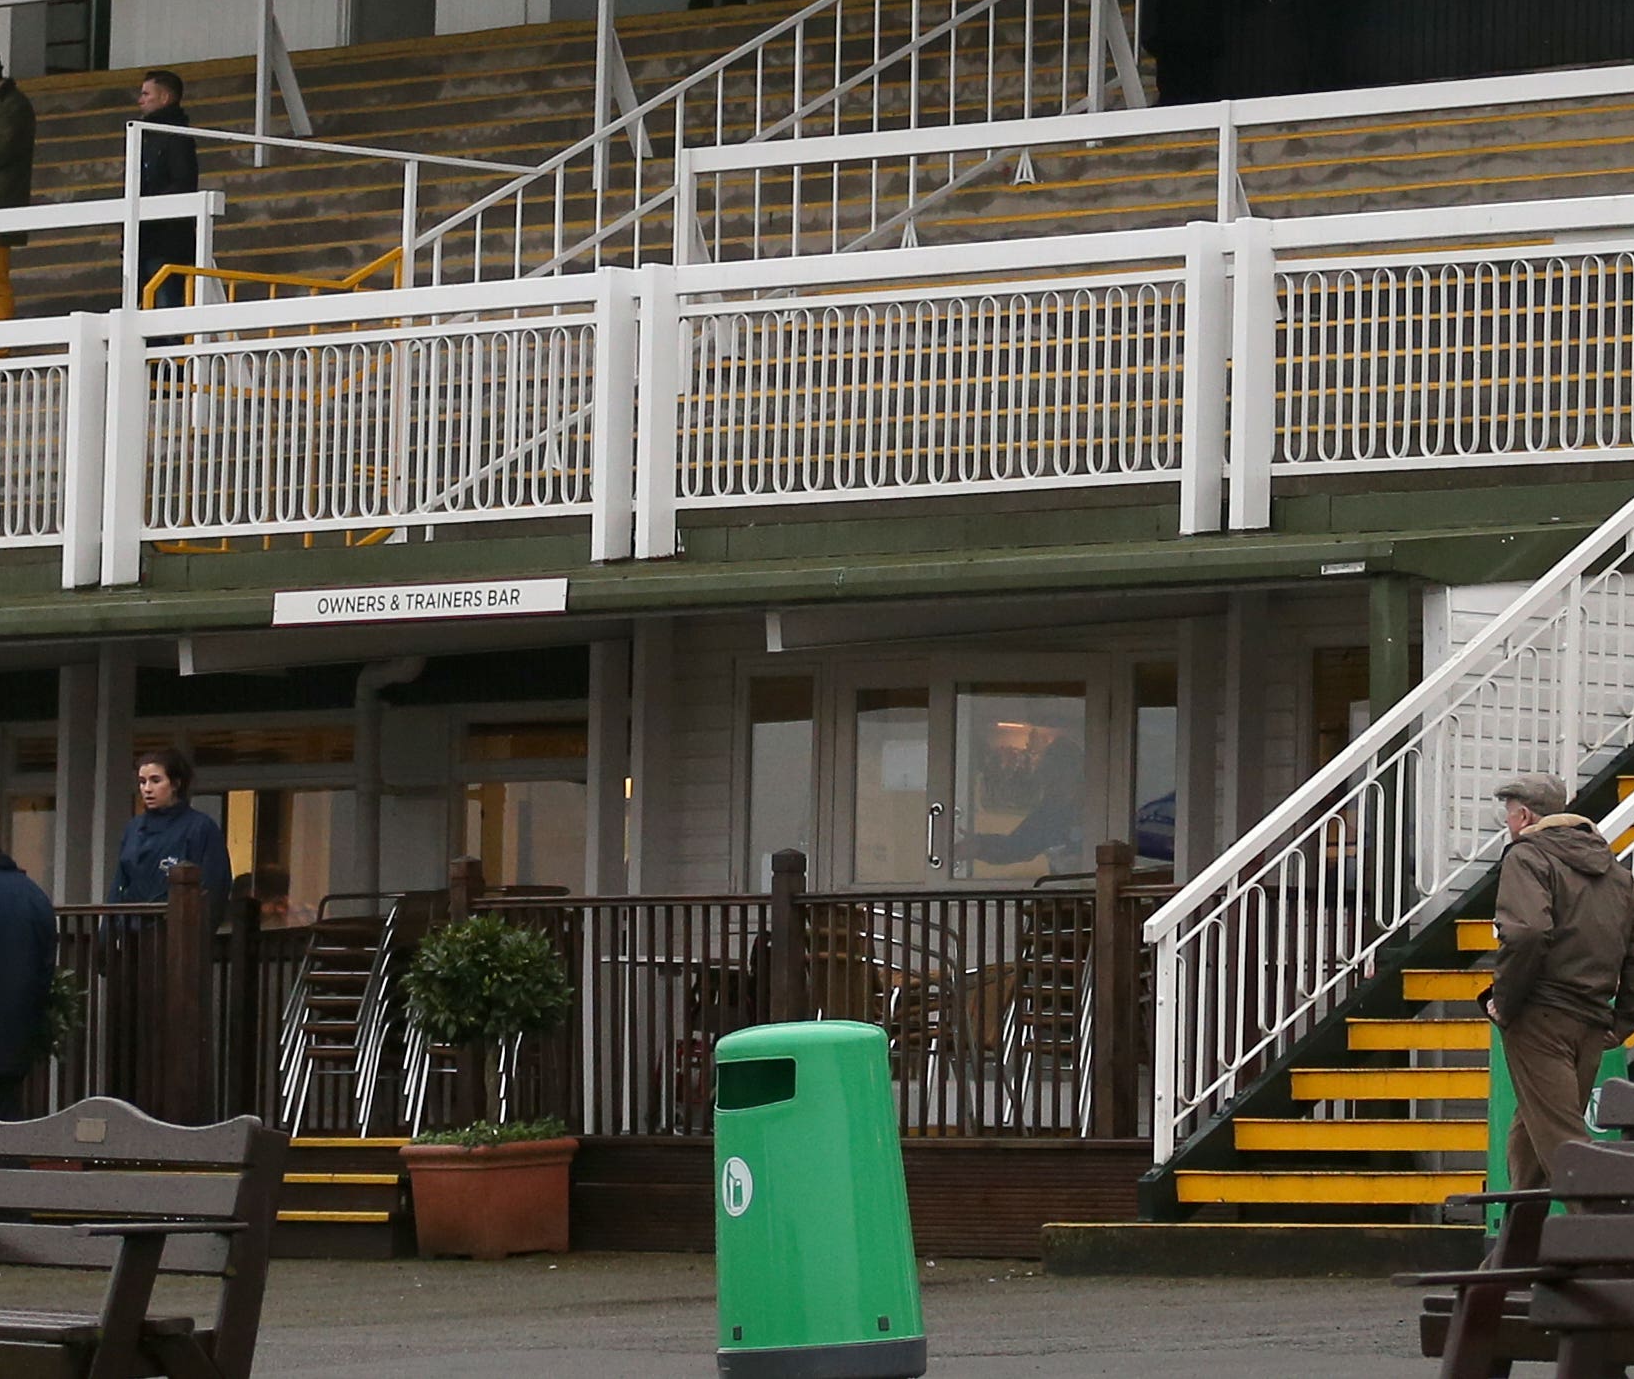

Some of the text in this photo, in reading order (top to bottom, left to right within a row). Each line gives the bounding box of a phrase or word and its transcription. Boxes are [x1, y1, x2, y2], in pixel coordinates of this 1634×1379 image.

[317, 588, 521, 614] OWNERS & TRAINERS BAR
